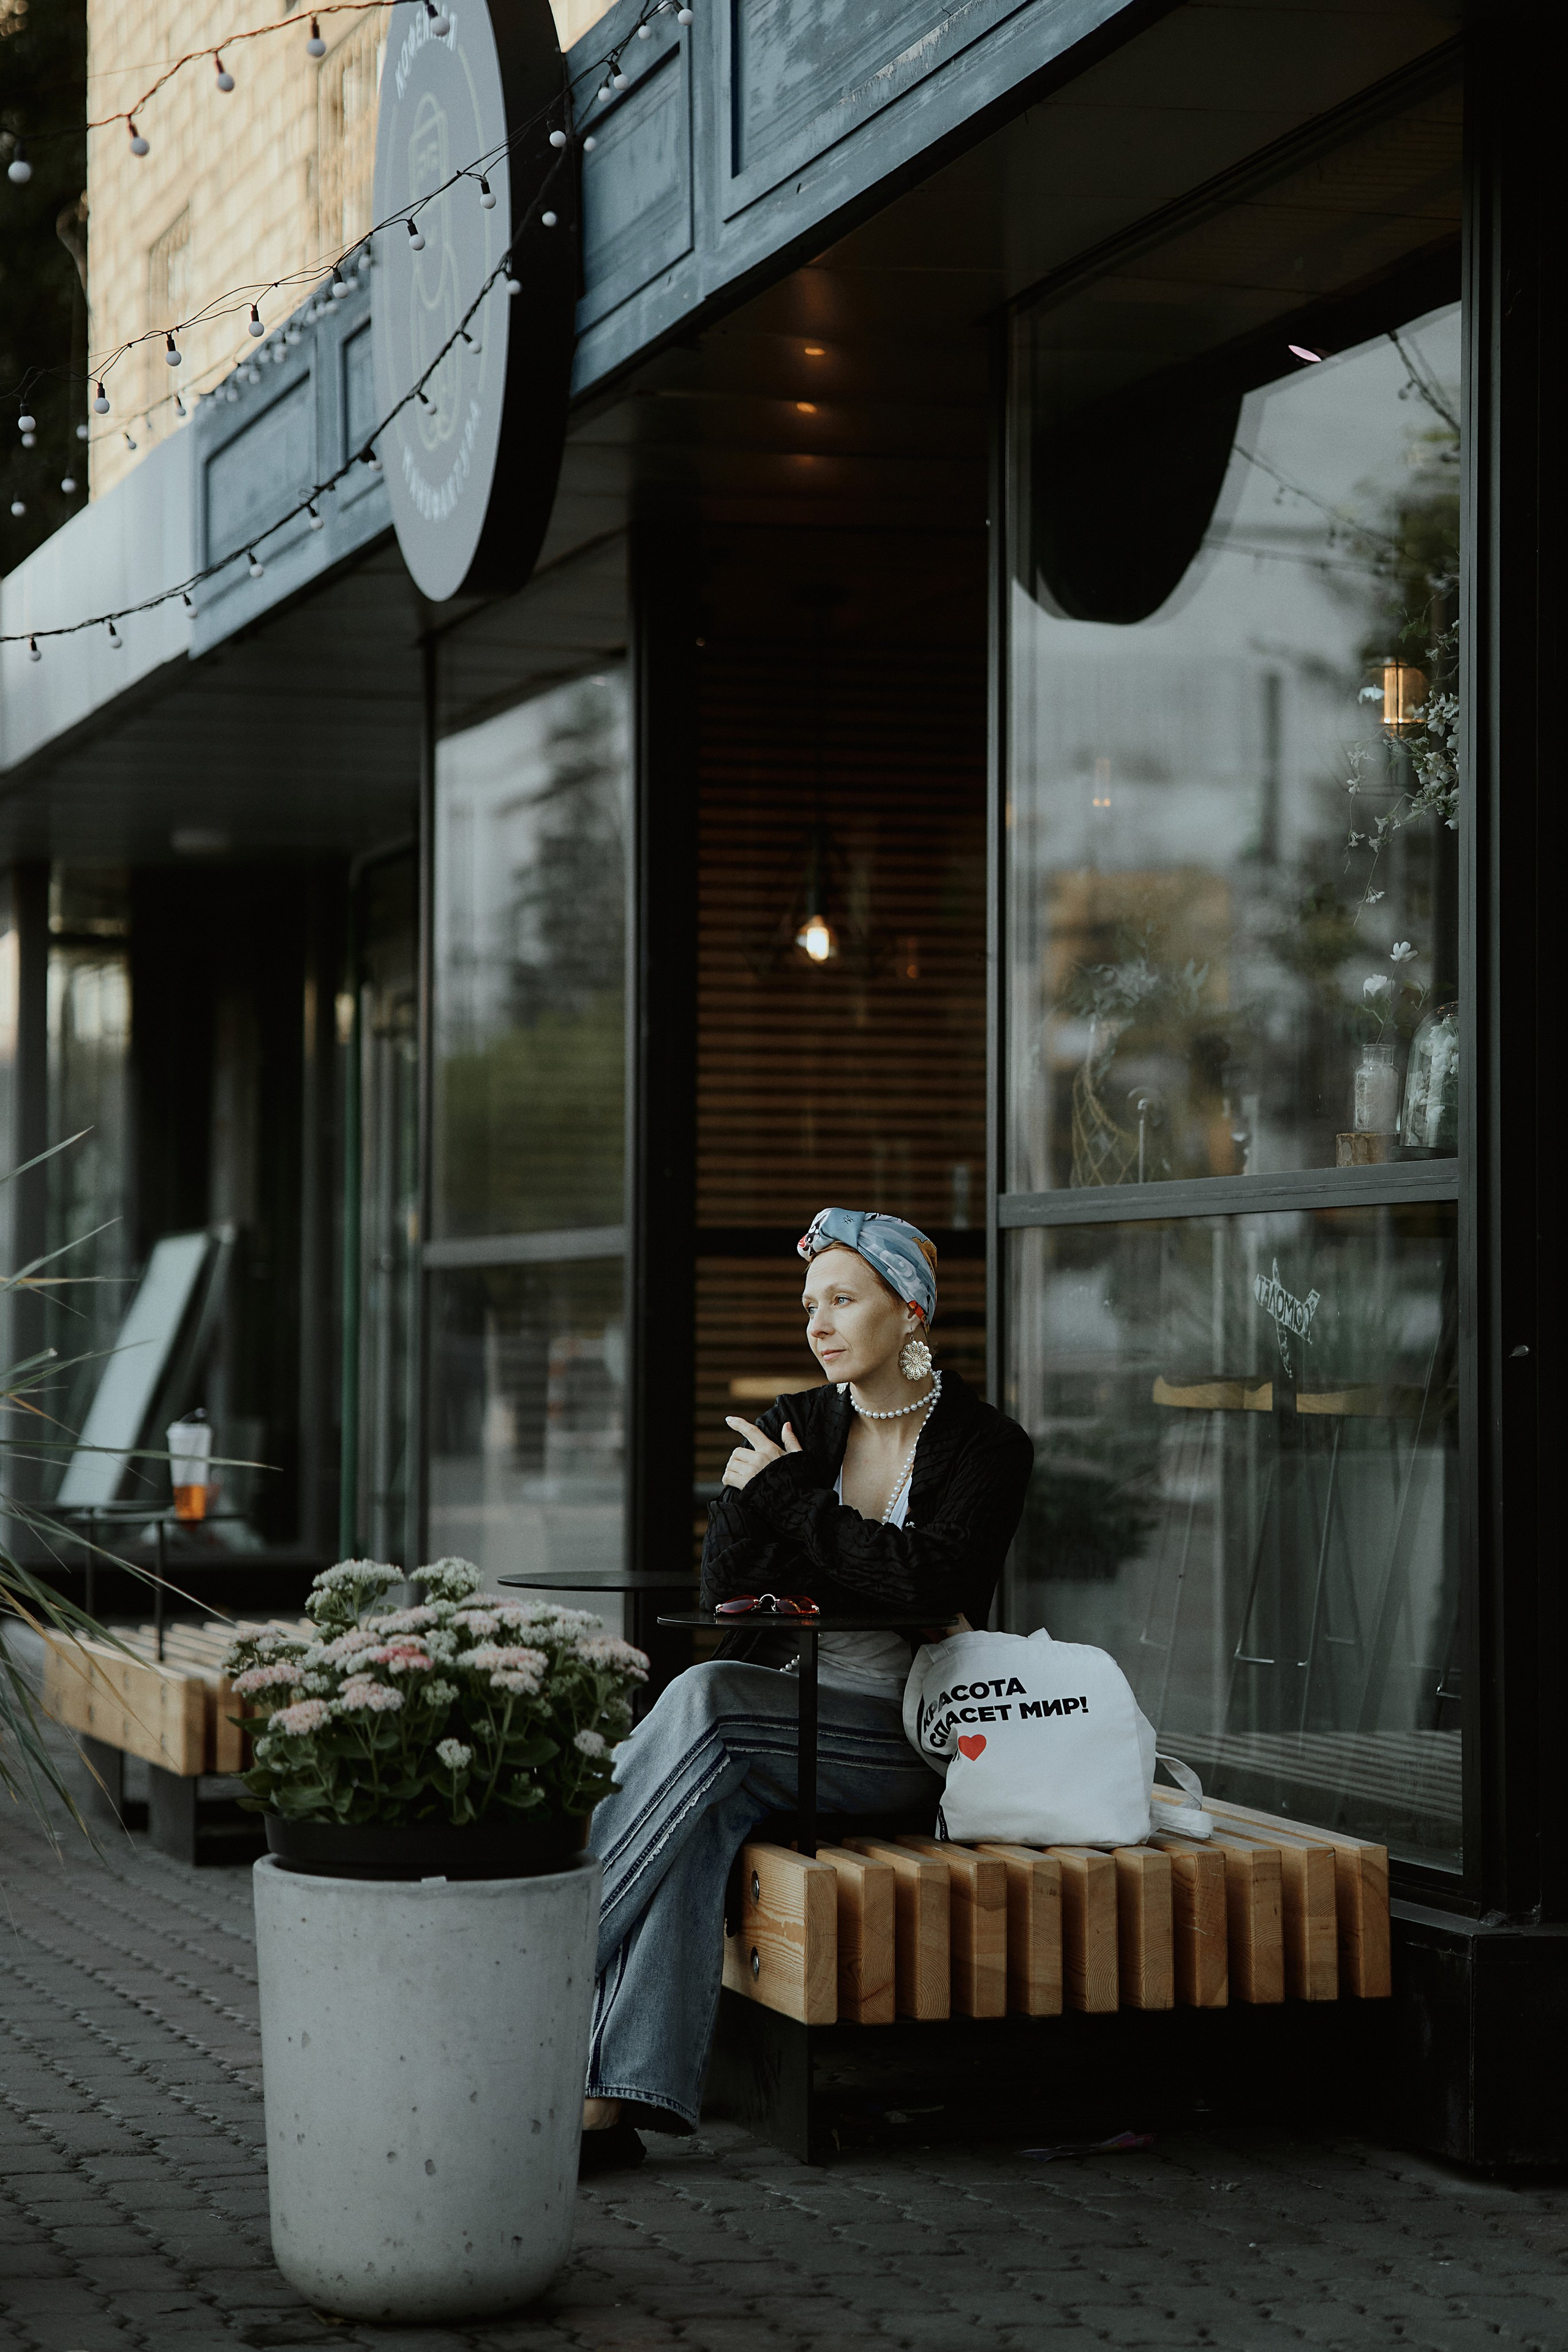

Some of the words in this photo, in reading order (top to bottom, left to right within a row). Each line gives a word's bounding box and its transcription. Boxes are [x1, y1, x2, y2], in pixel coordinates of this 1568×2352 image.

[924, 1677, 1027, 1733] КРАСОТА
[929, 1704, 1012, 1747] СПАСЕТ
[1019, 1696, 1089, 1719] МИР!
